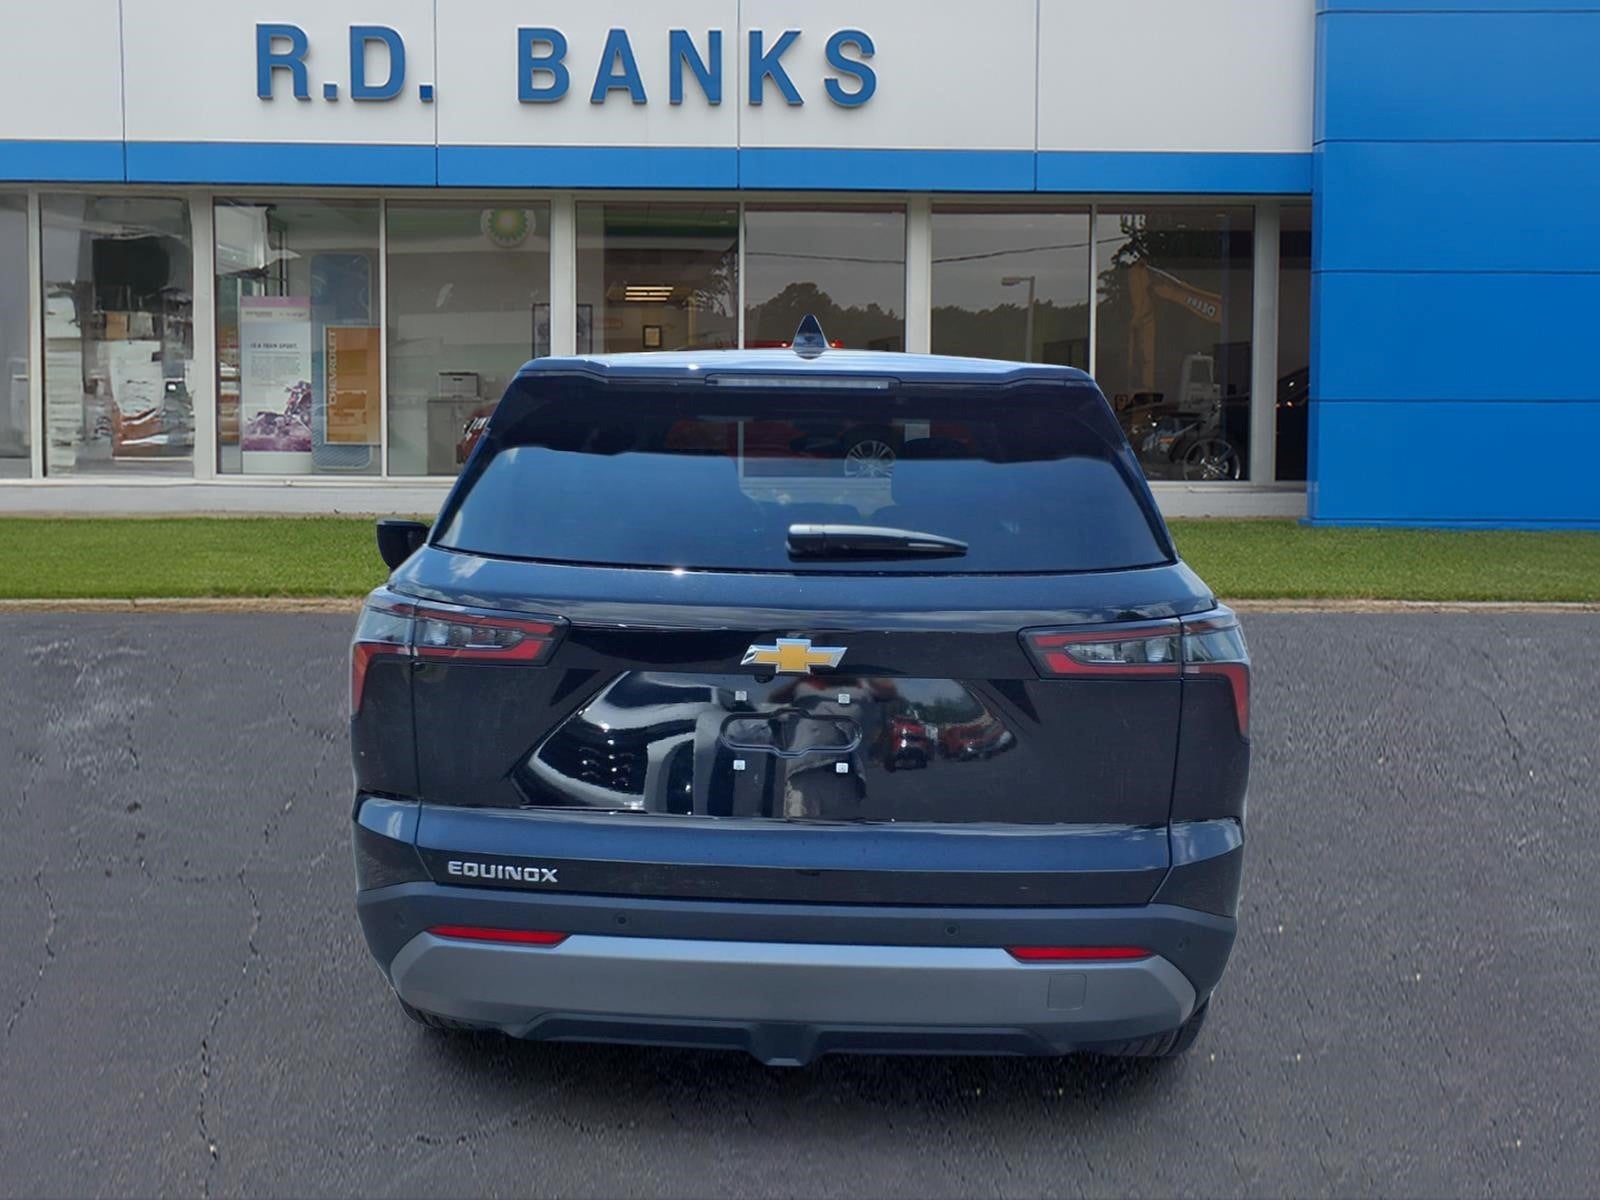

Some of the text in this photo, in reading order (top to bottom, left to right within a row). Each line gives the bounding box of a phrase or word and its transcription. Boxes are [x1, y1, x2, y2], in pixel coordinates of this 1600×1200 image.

[256, 23, 877, 107] R.D. BANKS
[328, 329, 337, 405] CHEVROLET
[448, 861, 558, 882] EQUINOX
